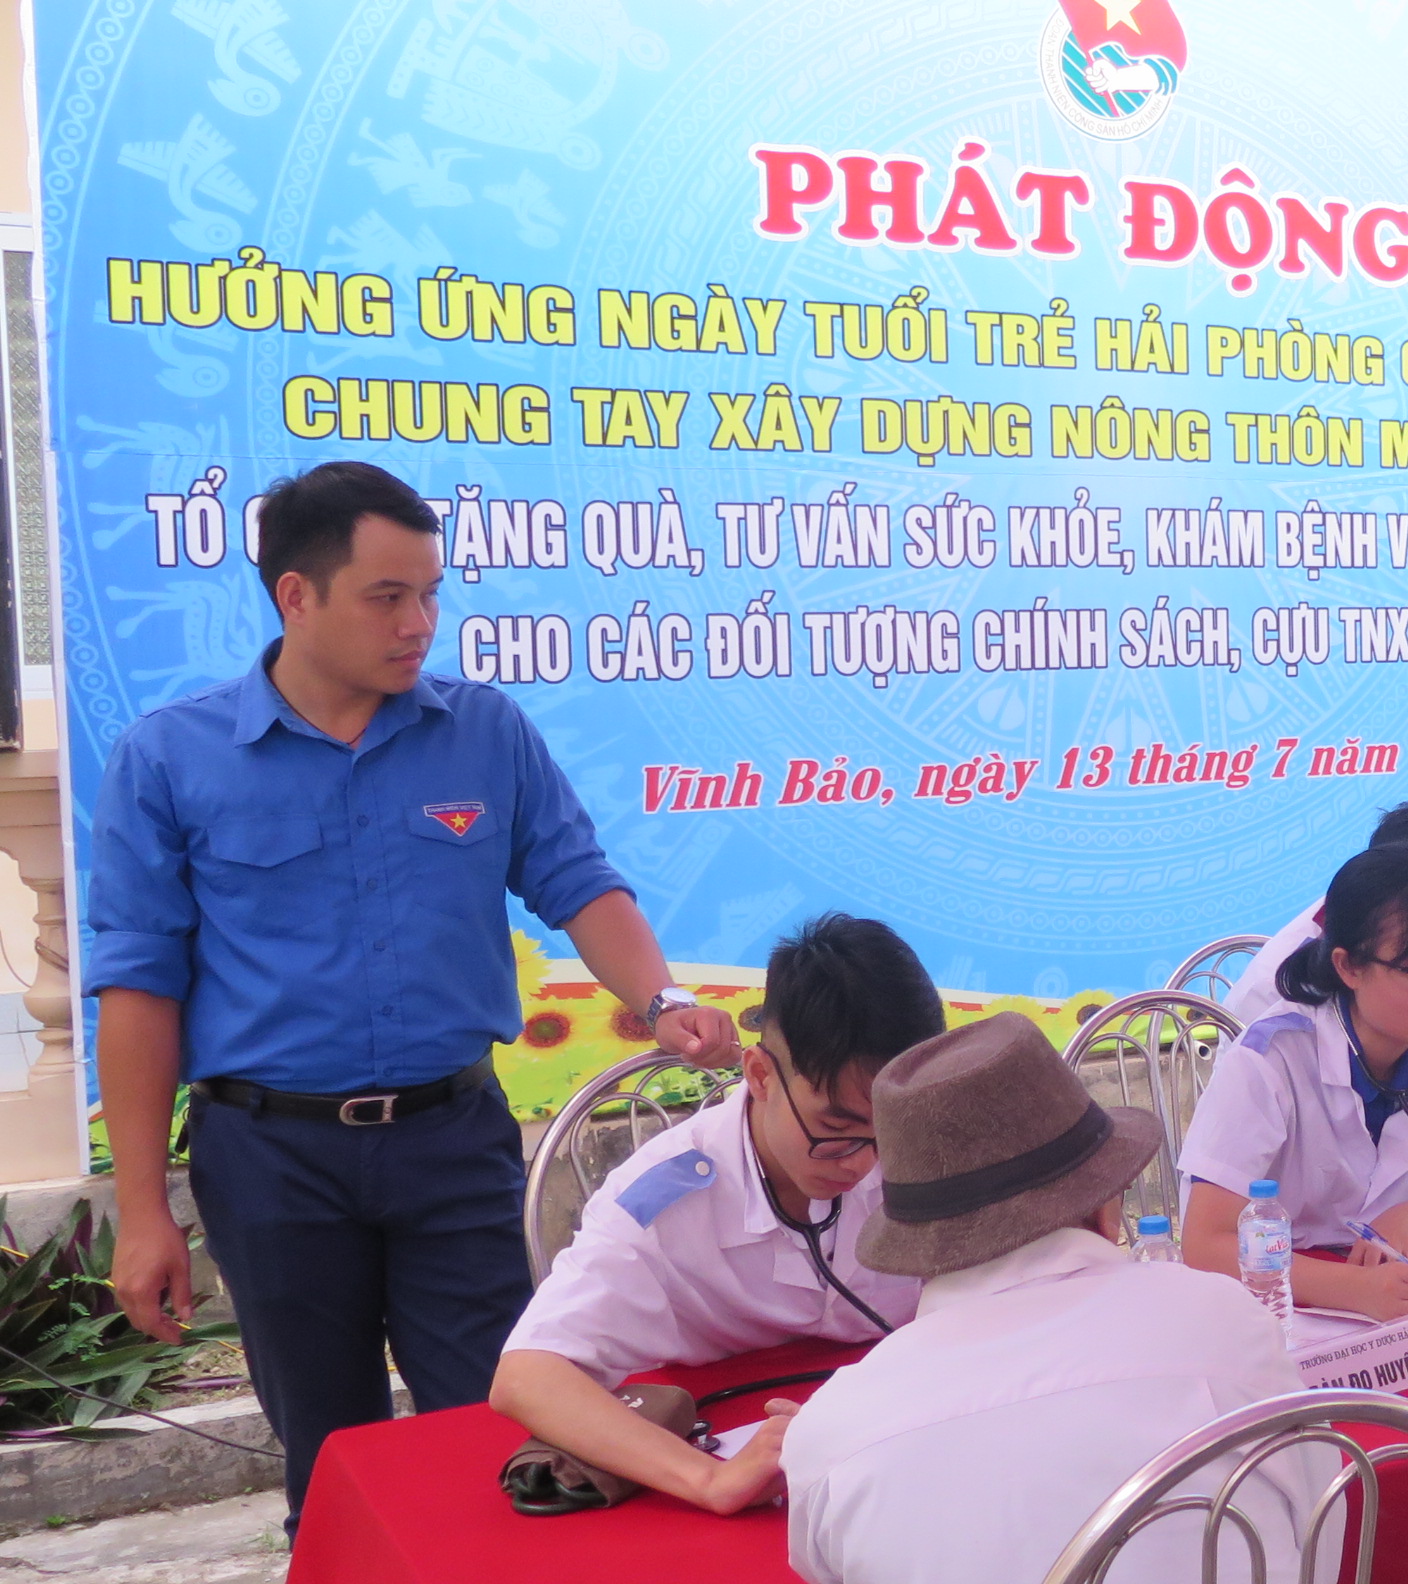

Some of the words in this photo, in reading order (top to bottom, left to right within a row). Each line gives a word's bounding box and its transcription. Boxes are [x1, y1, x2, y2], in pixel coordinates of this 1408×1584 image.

[755, 140, 1092, 255] PHÁT
[107, 245, 394, 337] HƯỞNG
[417, 266, 577, 346] ỨNG
[598, 283, 786, 355] NGÀY
[804, 286, 948, 364] TUỔI
[965, 298, 1077, 370] TRẺ
[1094, 304, 1189, 376] HẢI
[1206, 318, 1385, 388] PHÒNG
[283, 376, 552, 445] CHUNG
[570, 387, 689, 450] TAY
[709, 383, 841, 453] XÂY
[861, 395, 1032, 467] DỰNG
[1050, 395, 1211, 462] NÔNG
[1226, 405, 1364, 468] THÔN
[146, 466, 227, 568] TỔ
[582, 488, 704, 575] QUÀ,
[716, 497, 785, 569] TƯ
[791, 482, 891, 569] VẤN
[903, 492, 996, 570] SỨC
[1008, 487, 1136, 575] KHỎE,
[1145, 498, 1266, 569] KHÁM
[1275, 500, 1378, 582] BỆNH
[459, 614, 572, 684] CHO
[587, 600, 693, 682] CÁC
[706, 590, 792, 679] ĐỐI
[803, 605, 961, 689] TƯỢNG
[972, 597, 1109, 673] CHÍNH
[1118, 595, 1242, 674] SÁCH,
[1251, 602, 1331, 677] CỰU
[642, 760, 765, 815] Vĩnh
[776, 755, 896, 808] Bảo,
[911, 752, 1041, 807] ngày
[1054, 744, 1116, 791] 13
[1127, 741, 1259, 790] tháng
[1270, 737, 1300, 779] 7
[1307, 736, 1401, 777] năm
[1299, 1353, 1334, 1371] TRƯỜNG
[1350, 1342, 1368, 1356] HỌC
[1368, 1340, 1374, 1350] Y
